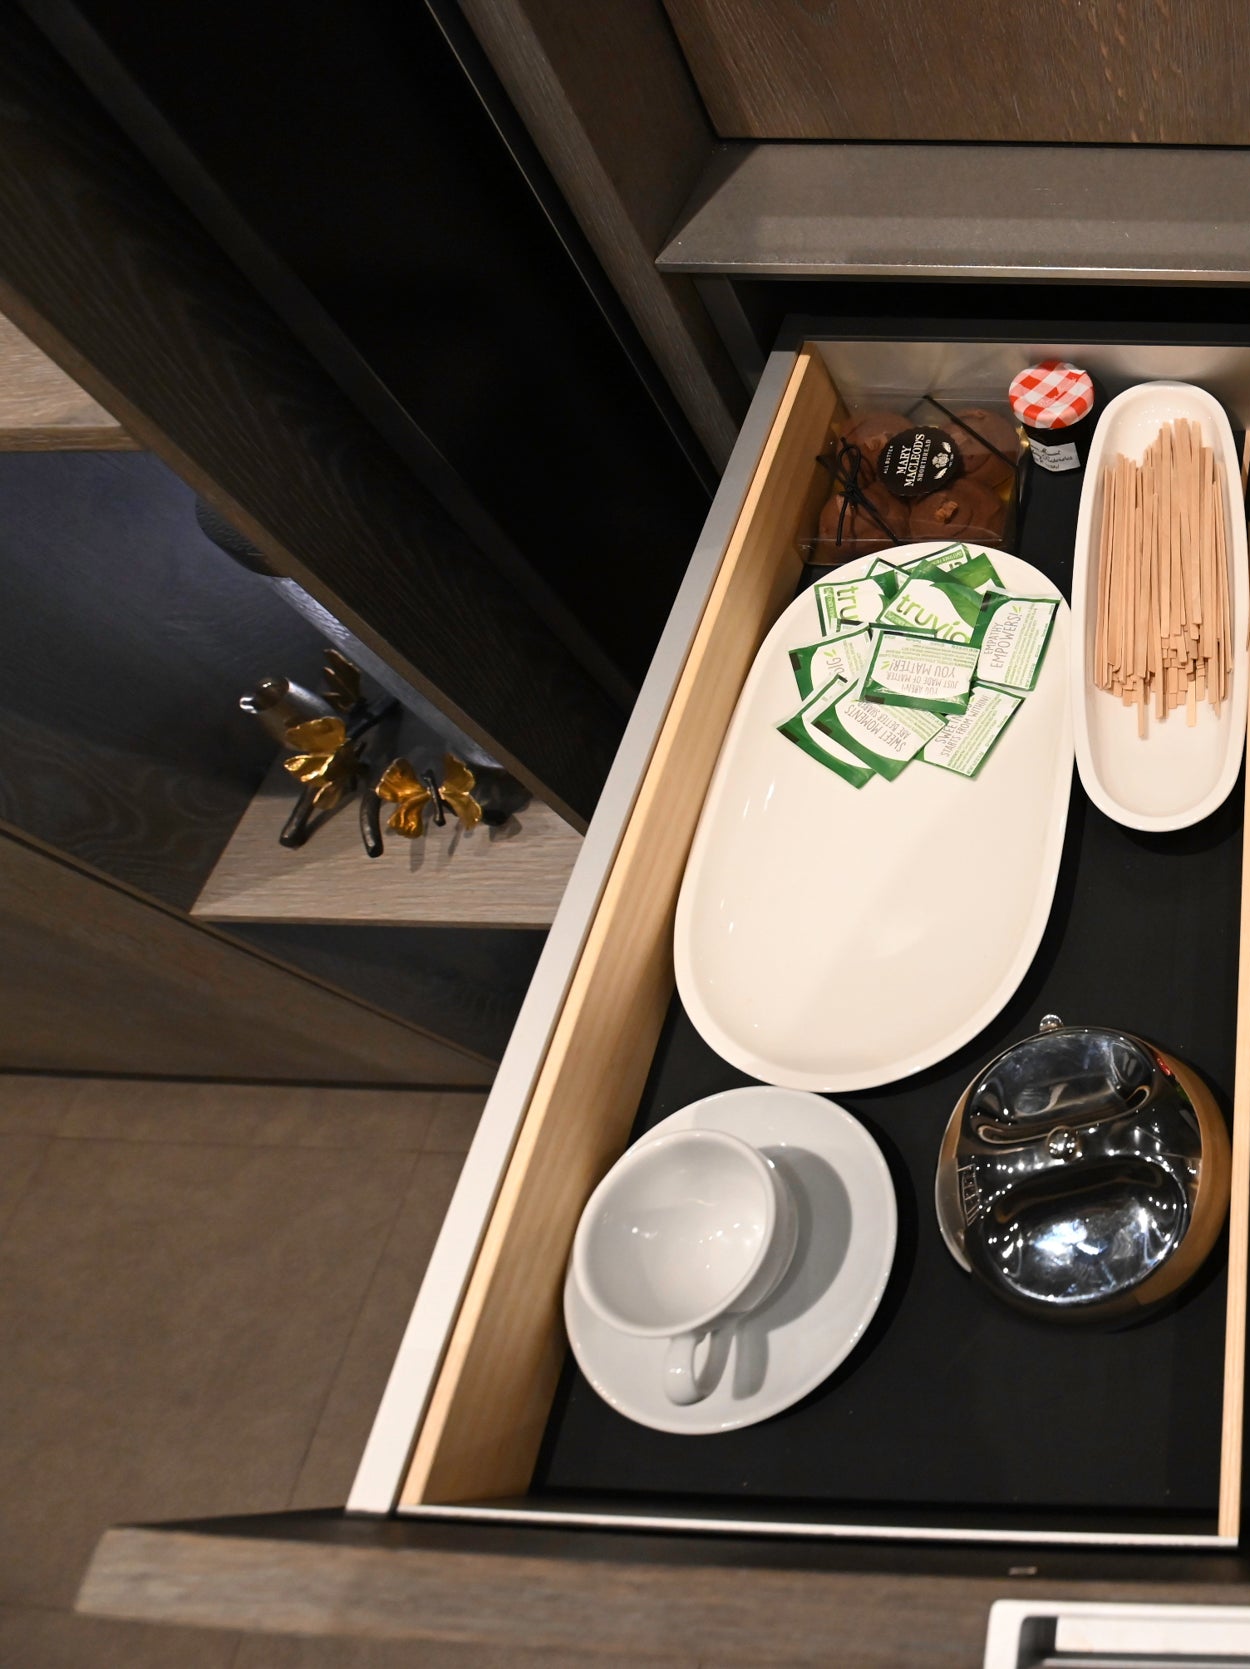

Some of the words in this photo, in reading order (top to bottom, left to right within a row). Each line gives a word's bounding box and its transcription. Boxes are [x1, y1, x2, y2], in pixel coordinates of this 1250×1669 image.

[896, 445, 911, 474] MARY
[904, 434, 925, 487] MACLEOD'S
[917, 439, 931, 482] SHORTBREAD
[984, 622, 1003, 655] EMPATHY
[990, 612, 1022, 669] EMPOWERS!
[886, 672, 911, 683] MATTER
[889, 658, 932, 676] MATTER!
[935, 666, 956, 678] YOU
[912, 675, 921, 685] OF
[923, 677, 942, 687] MADE
[925, 686, 939, 696] YOU
[943, 680, 959, 689] JUST
[844, 704, 882, 734] MOMENTS
[879, 730, 906, 752] SWEET
[941, 736, 961, 757] STARTS
[956, 718, 973, 735] FROM
